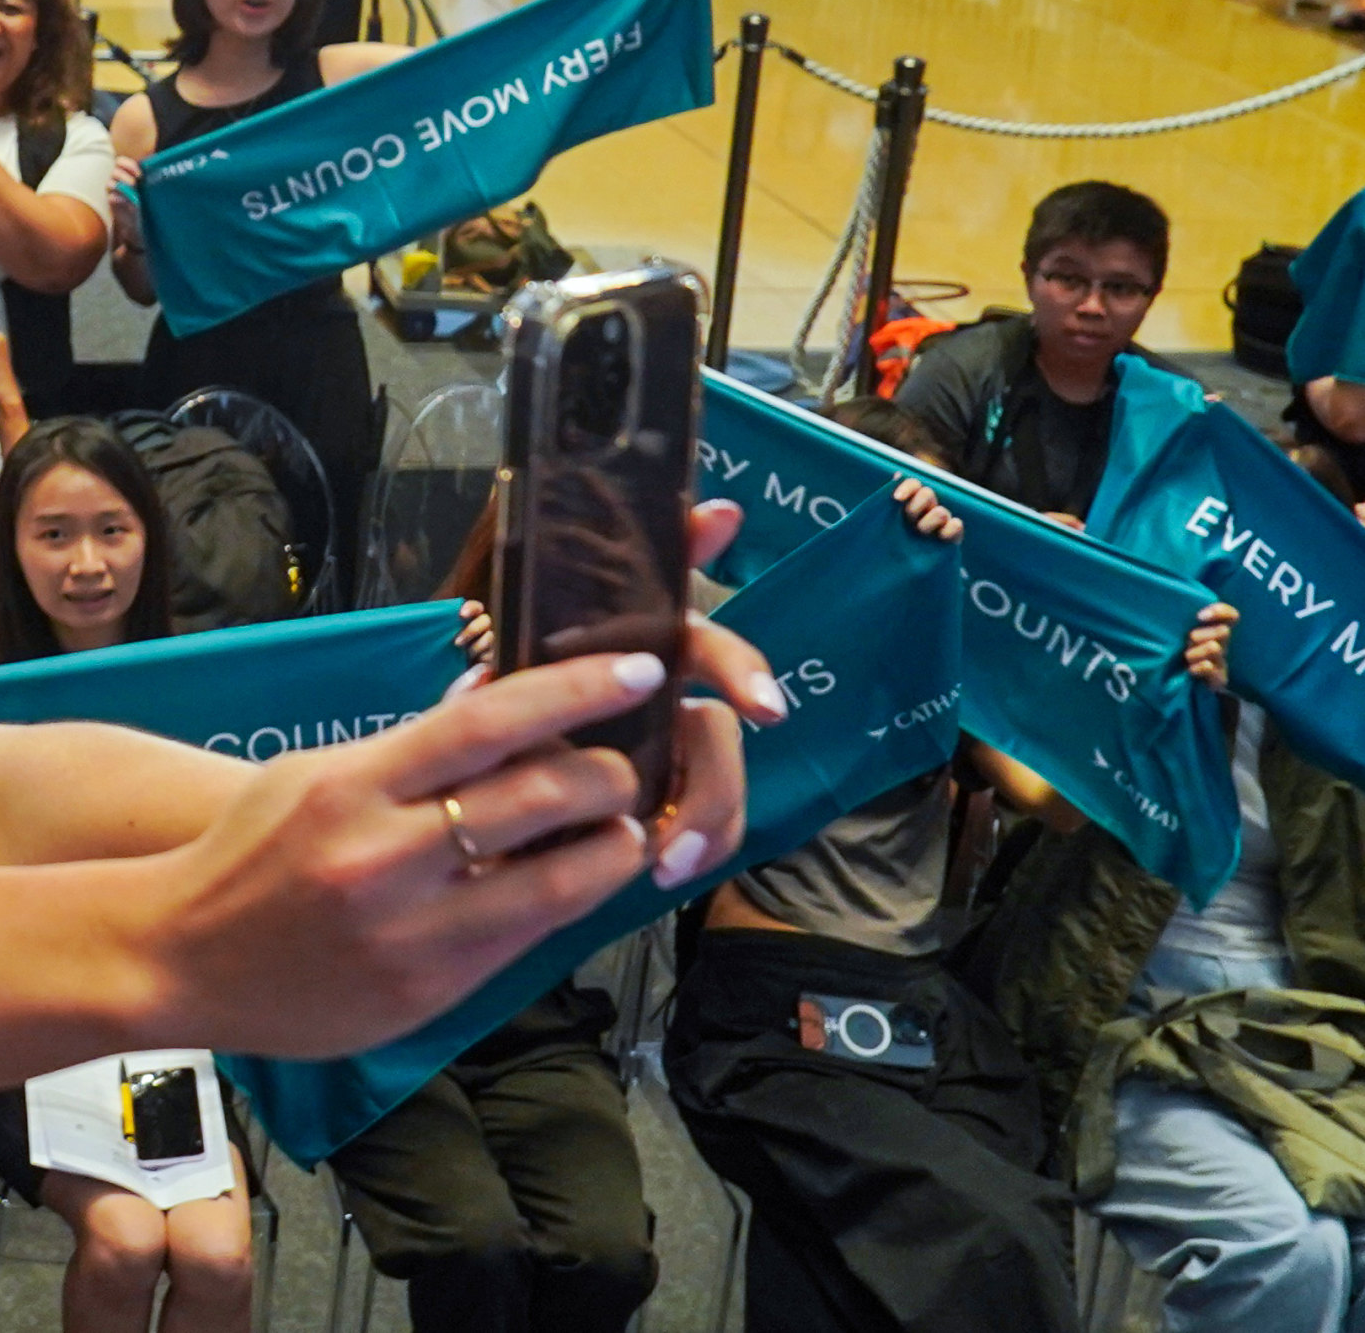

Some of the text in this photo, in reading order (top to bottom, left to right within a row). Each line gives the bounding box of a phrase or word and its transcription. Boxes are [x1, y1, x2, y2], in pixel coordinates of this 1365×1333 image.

[414, 77, 529, 152] MOVE
[240, 132, 407, 222] COUNTS
[1185, 495, 1335, 619] EVERY
[960, 568, 1138, 703] OUNTS
[204, 712, 422, 764] COUNT
